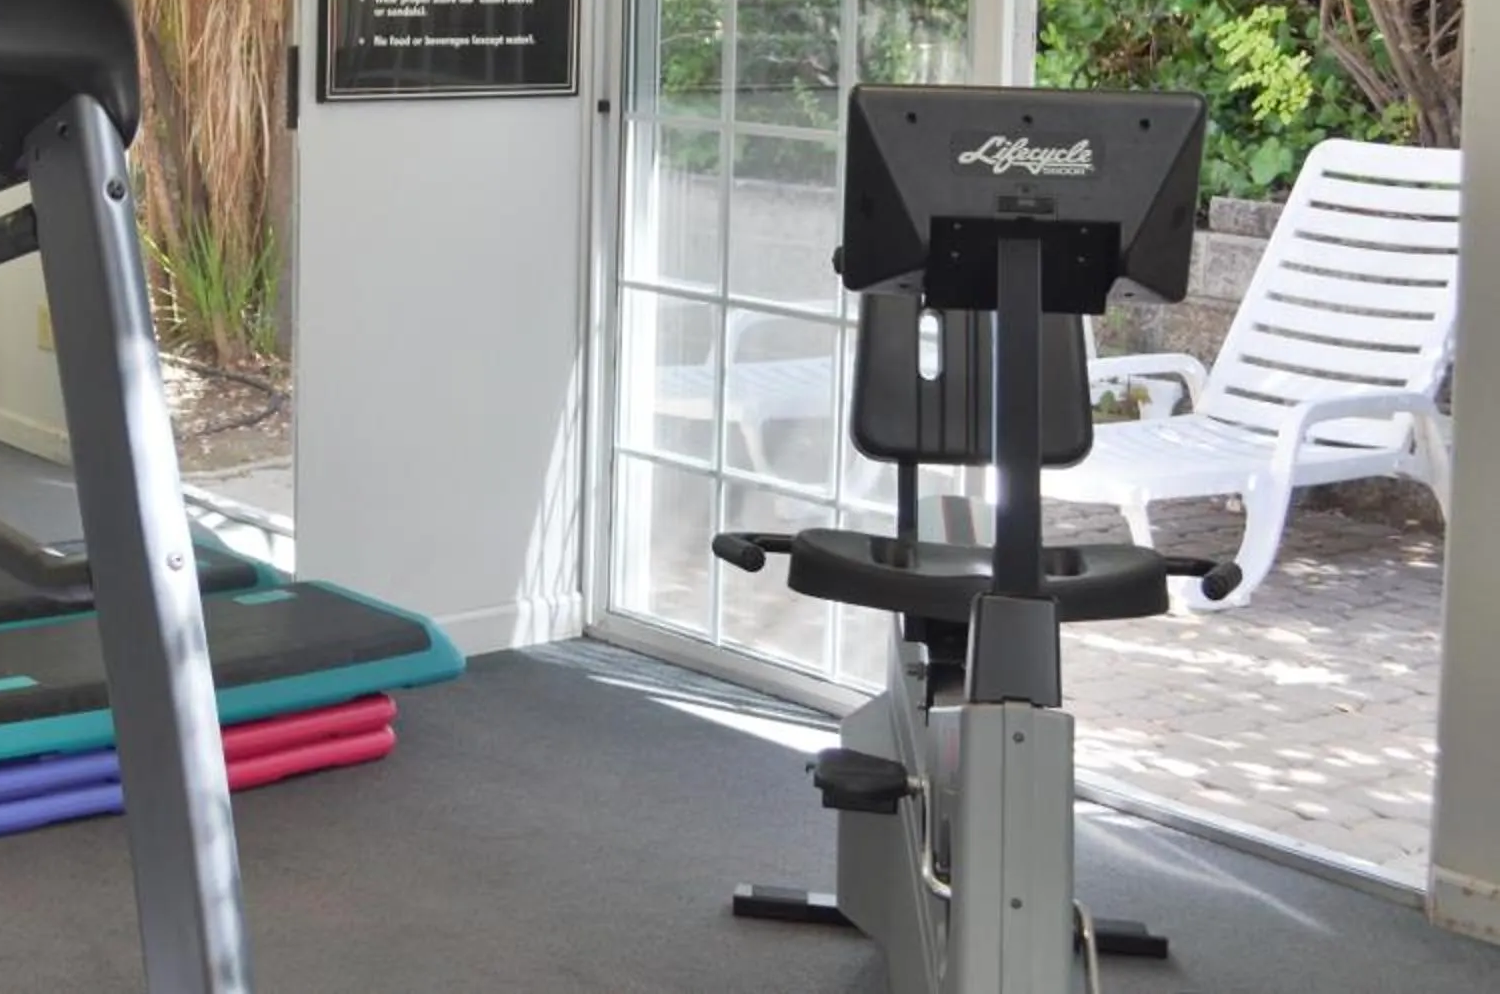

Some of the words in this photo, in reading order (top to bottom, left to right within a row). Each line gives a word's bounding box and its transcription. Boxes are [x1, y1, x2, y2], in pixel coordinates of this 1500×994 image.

[374, 7, 385, 16] or
[374, 35, 388, 46] No
[390, 35, 411, 46] food
[413, 37, 423, 46] or
[425, 35, 470, 49] beverages
[958, 135, 1093, 175] Lifecycle
